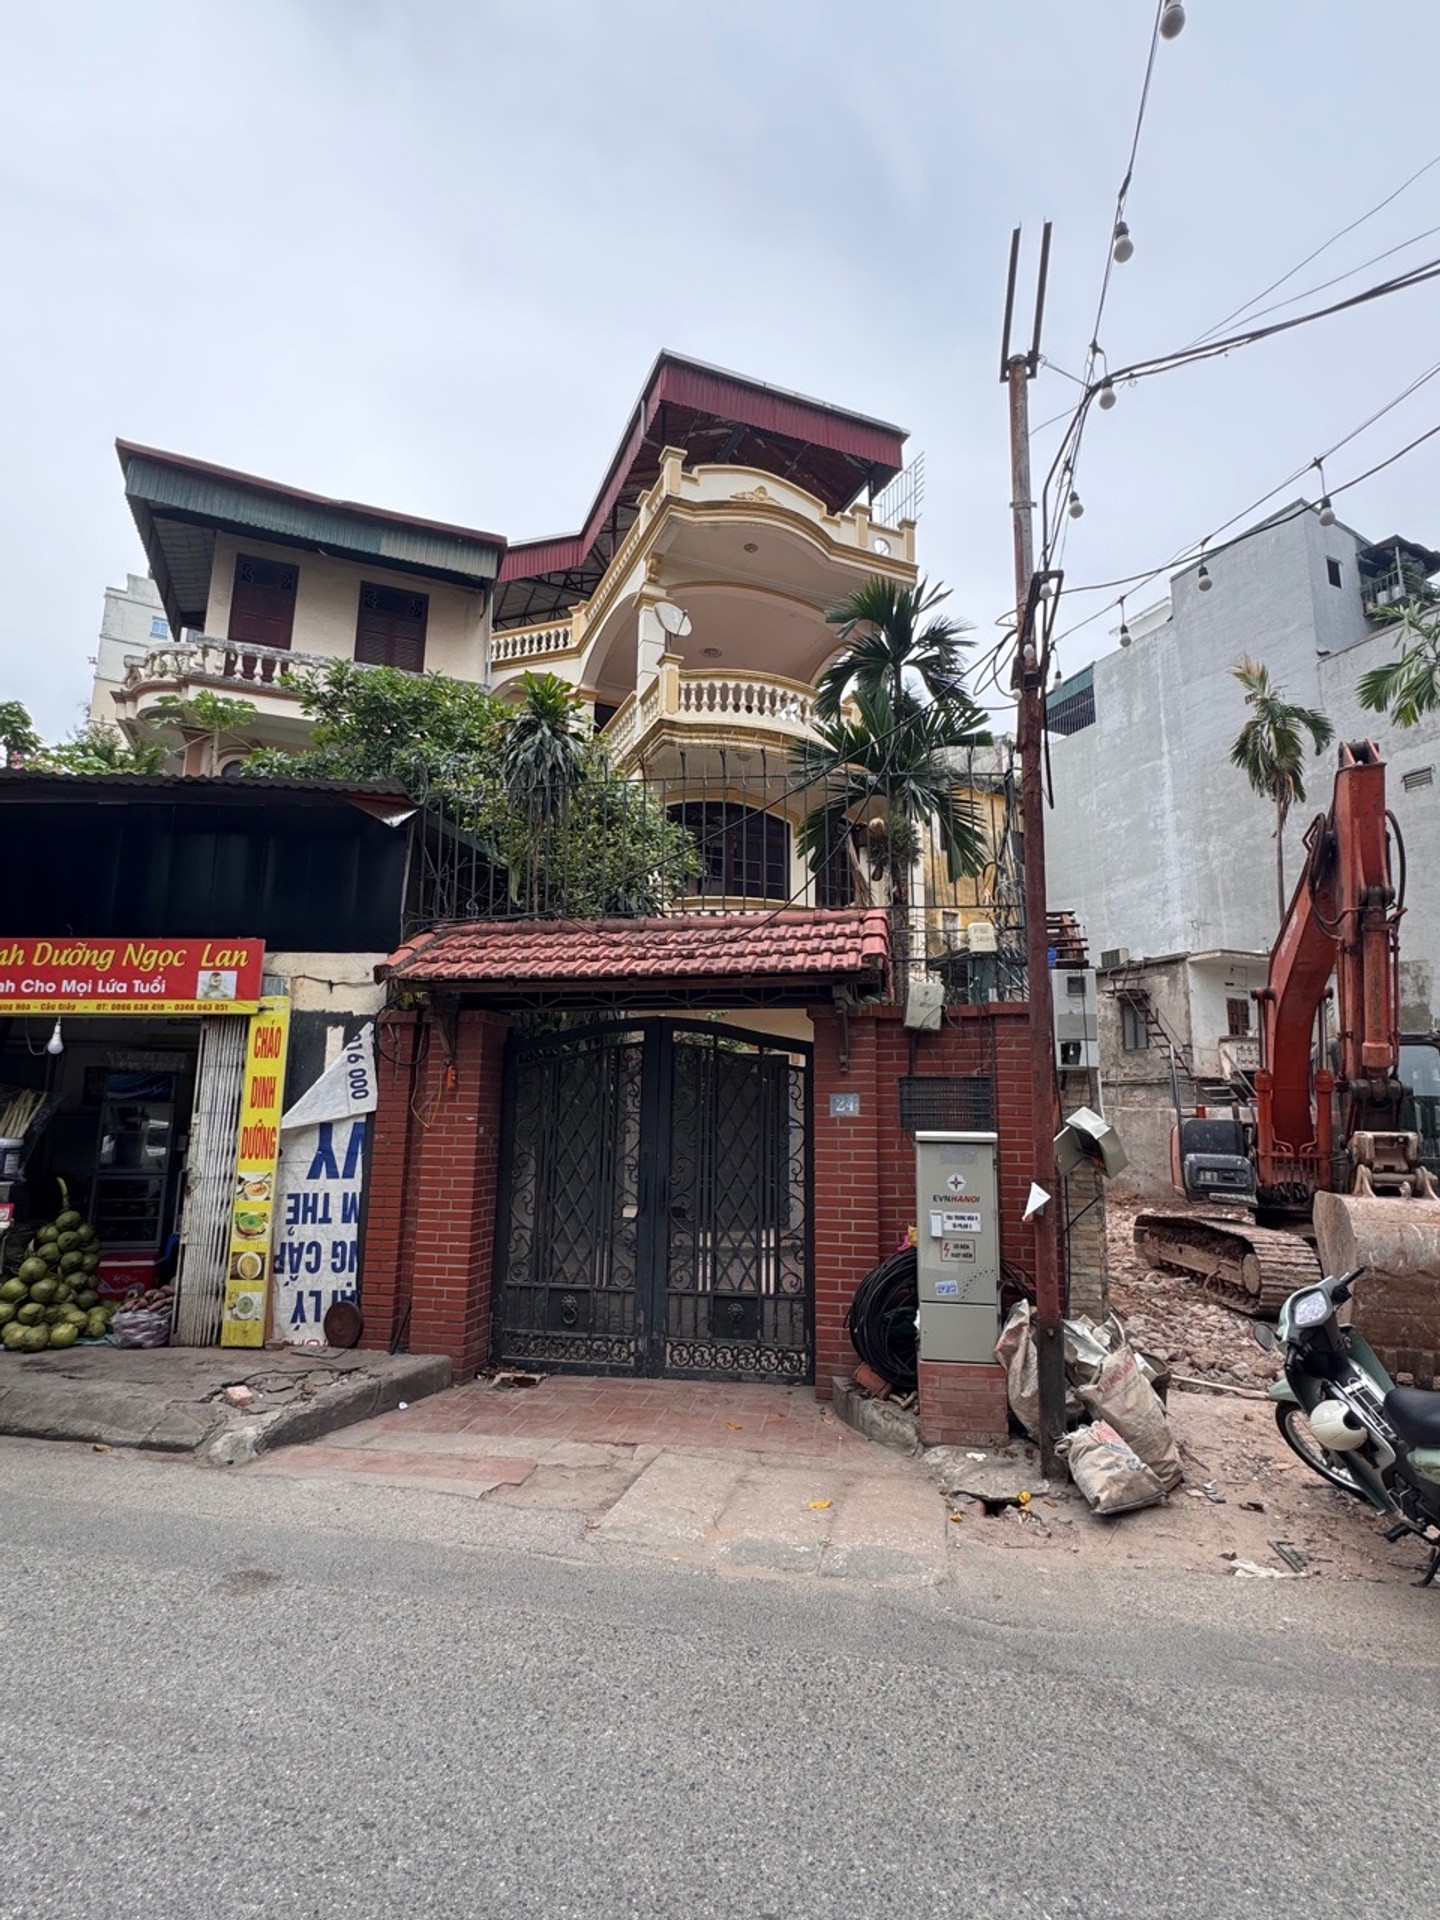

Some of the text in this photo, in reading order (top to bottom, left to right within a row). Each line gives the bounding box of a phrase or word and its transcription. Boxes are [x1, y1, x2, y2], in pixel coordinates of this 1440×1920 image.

[32, 942, 116, 972] Dưỡng
[121, 943, 187, 972] Ngọc
[201, 943, 249, 967] Lan
[21, 979, 57, 993] Cho
[61, 979, 92, 997] Mọi
[97, 978, 128, 993] Lứa
[132, 975, 166, 993] Tuổi
[253, 1020, 282, 1059] CHÁO
[250, 1076, 277, 1108] DINH
[348, 1068, 369, 1099] 000
[835, 1099, 855, 1111] 24
[240, 1119, 277, 1160] DƯỠNG
[285, 1192, 332, 1236] THẺ
[933, 1194, 981, 1203] EVNHANOI
[290, 1290, 322, 1332] LÝ
